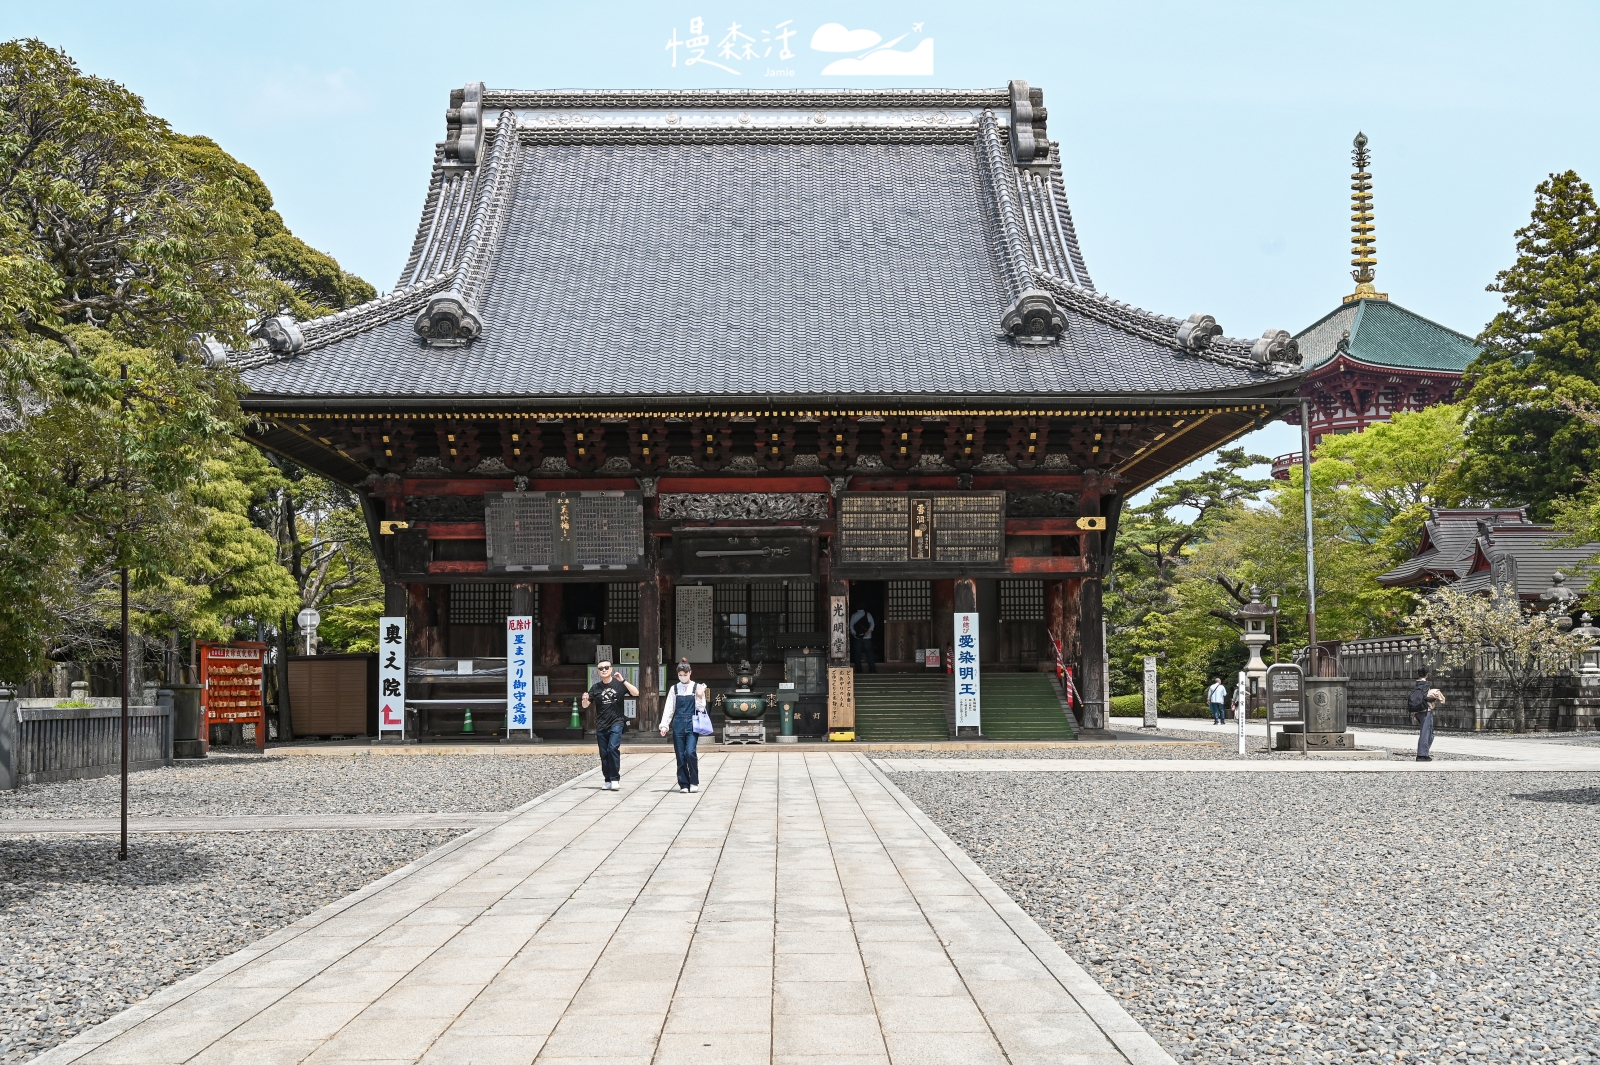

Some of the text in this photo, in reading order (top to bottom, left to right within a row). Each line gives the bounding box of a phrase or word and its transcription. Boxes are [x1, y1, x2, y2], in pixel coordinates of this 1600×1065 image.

[508, 619, 531, 631] 厄除け
[833, 603, 844, 654] 光明堂
[382, 623, 402, 697] 奥之院
[512, 634, 527, 725] 星まつり御守受場
[958, 634, 975, 695] 愛染明王
